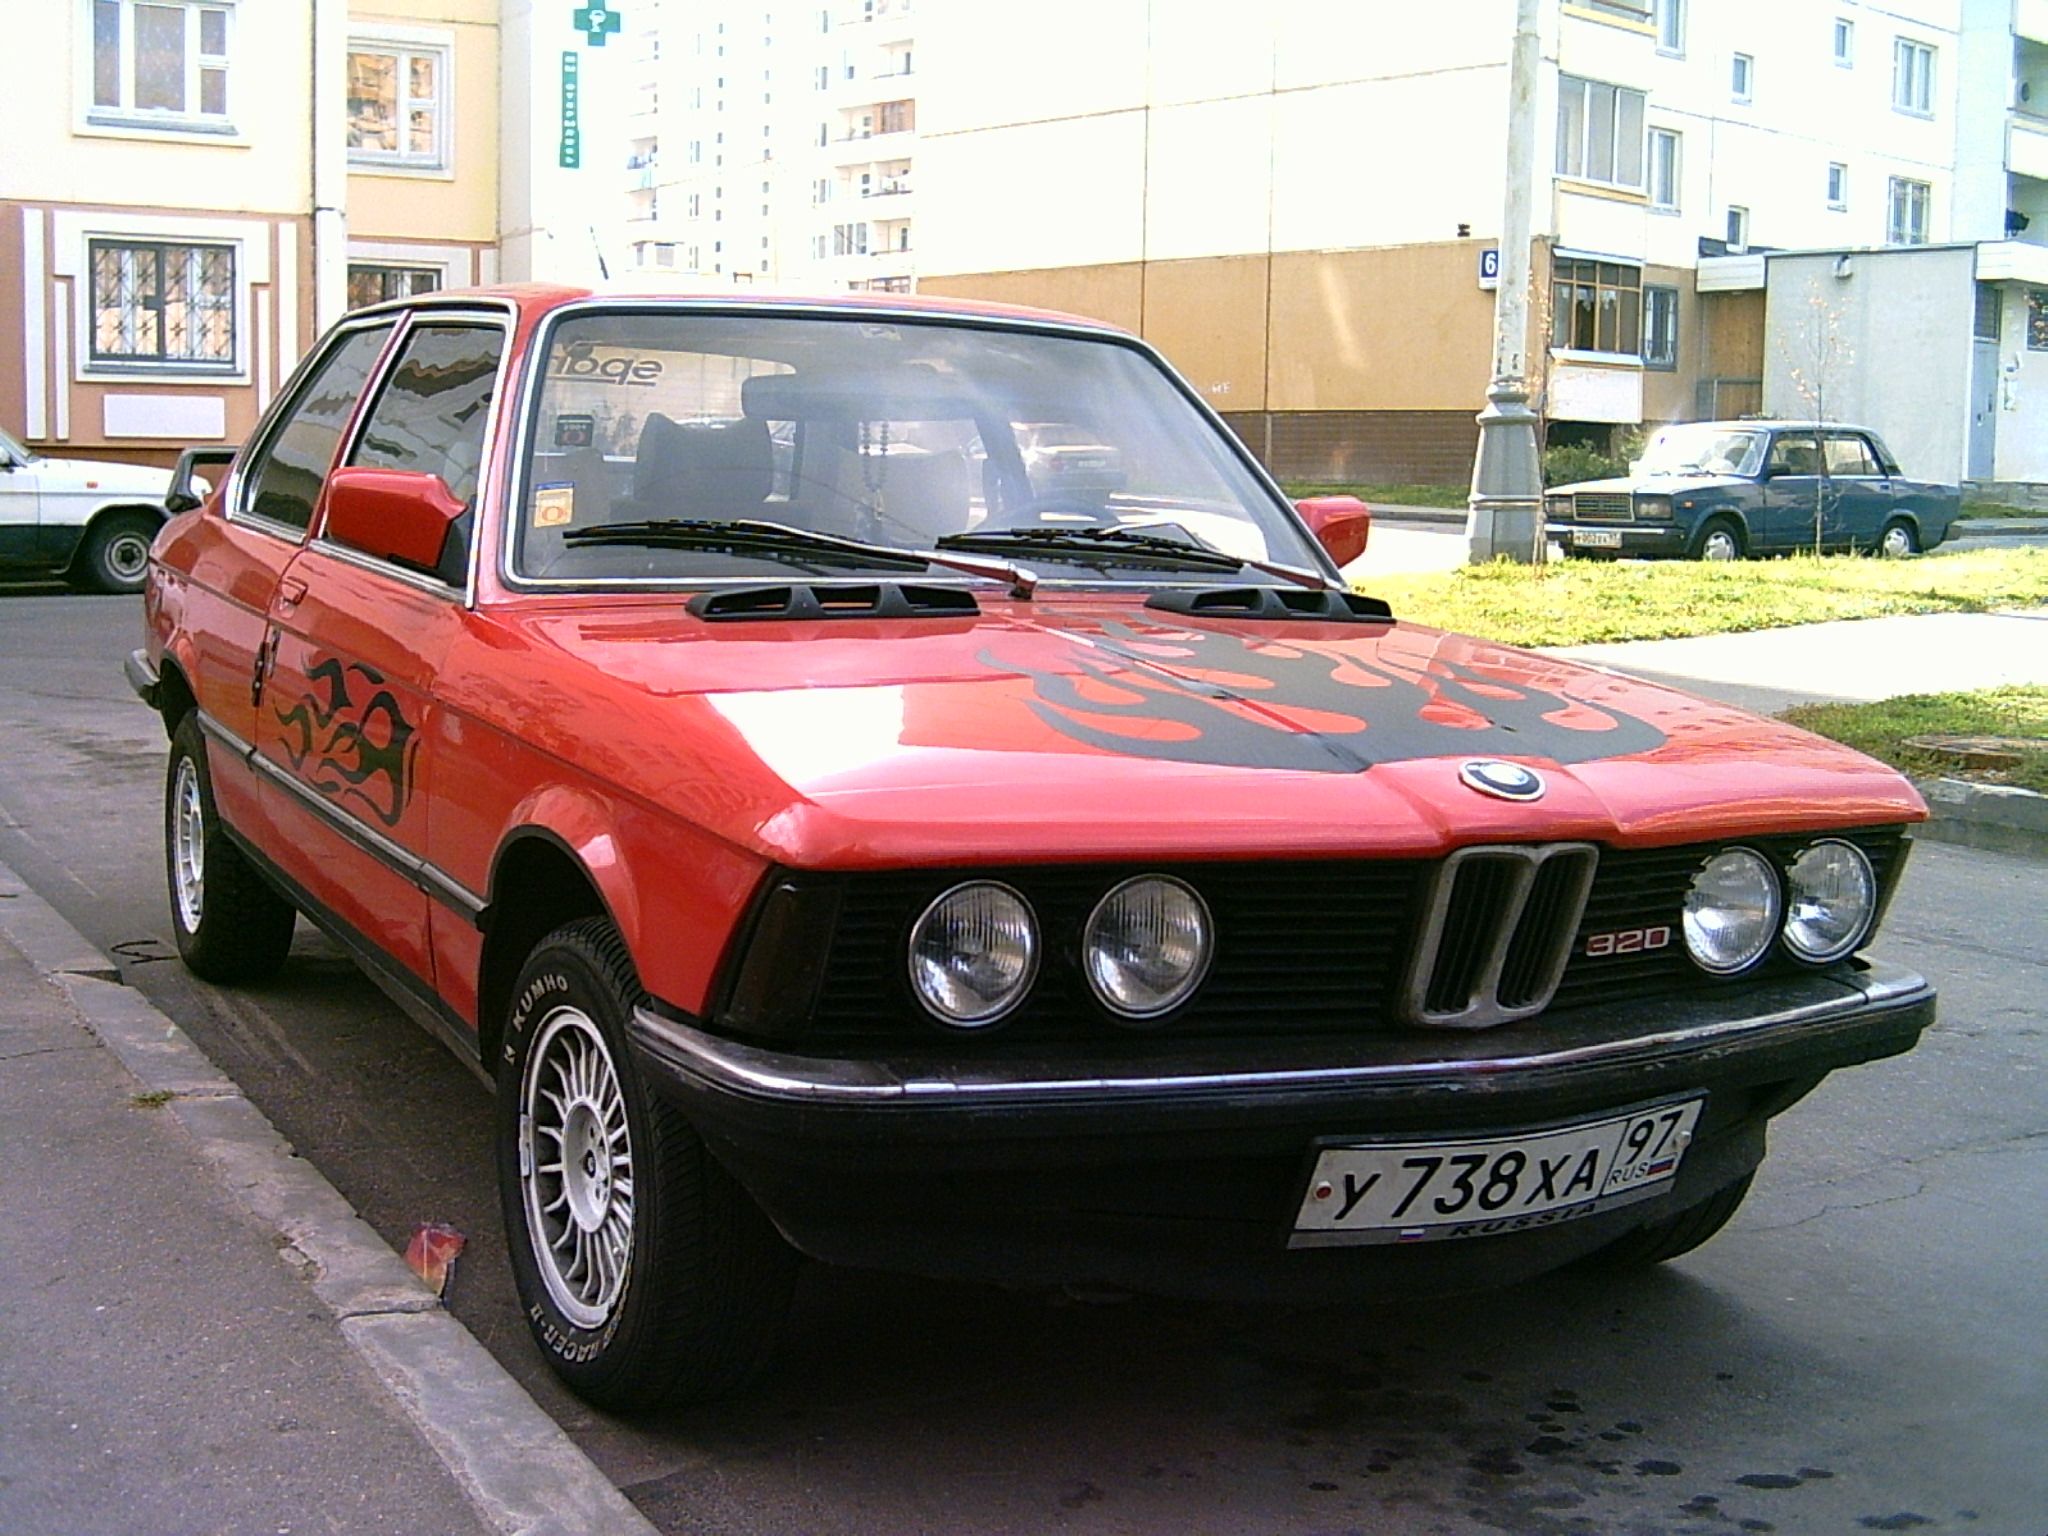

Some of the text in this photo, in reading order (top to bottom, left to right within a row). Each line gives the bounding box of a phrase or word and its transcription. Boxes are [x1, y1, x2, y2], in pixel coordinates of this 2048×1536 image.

[1484, 252, 1497, 275] 6
[1585, 926, 1671, 957] 320
[512, 974, 569, 1033] KUMHO
[1624, 1109, 1685, 1165] 97
[1608, 1160, 1650, 1188] RUS
[1447, 1201, 1598, 1237] RUSSIA
